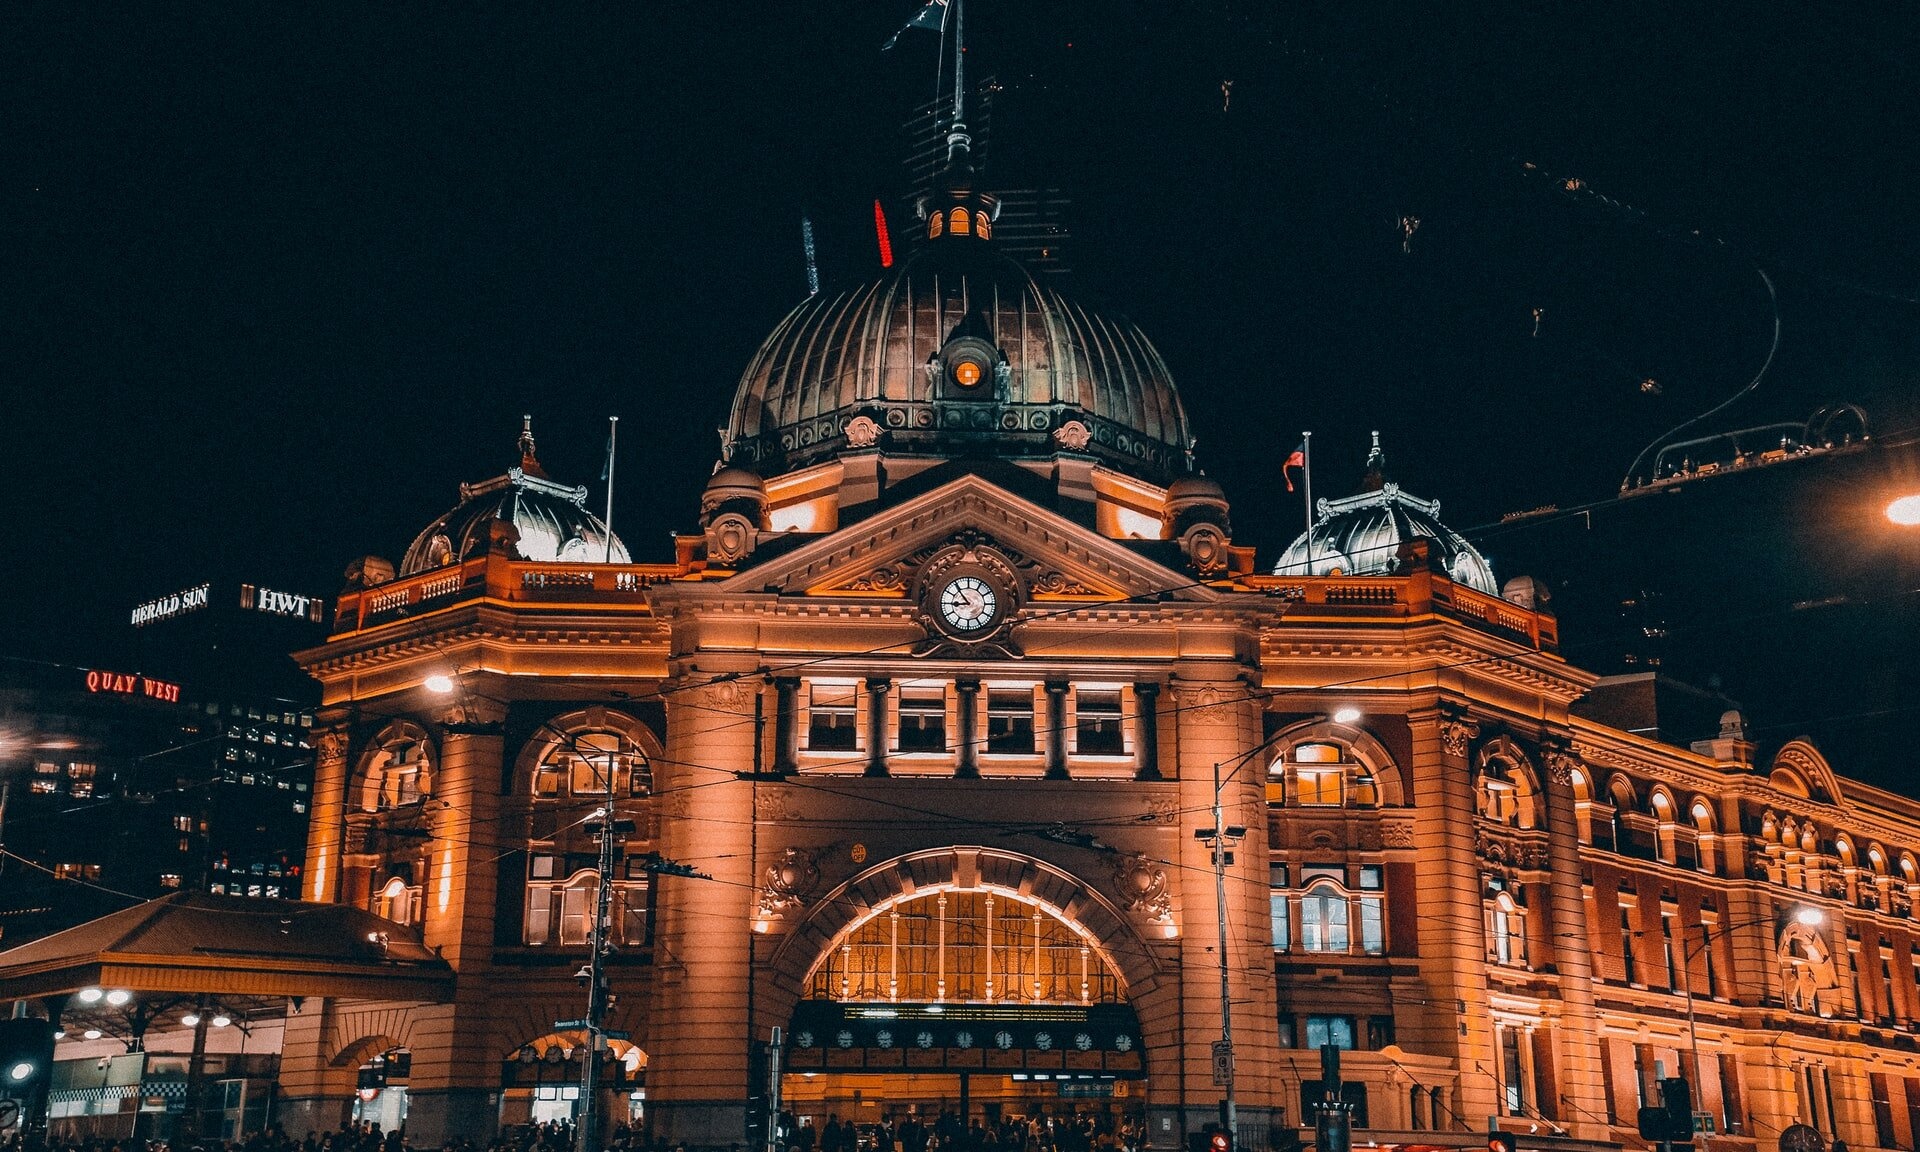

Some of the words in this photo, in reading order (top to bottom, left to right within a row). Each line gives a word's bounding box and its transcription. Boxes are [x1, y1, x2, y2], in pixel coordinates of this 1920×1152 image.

[131, 596, 180, 624] HERALD
[182, 587, 208, 609] SUN
[258, 588, 310, 616] HWT
[87, 671, 137, 693] QUAY
[144, 679, 180, 703] WEST
